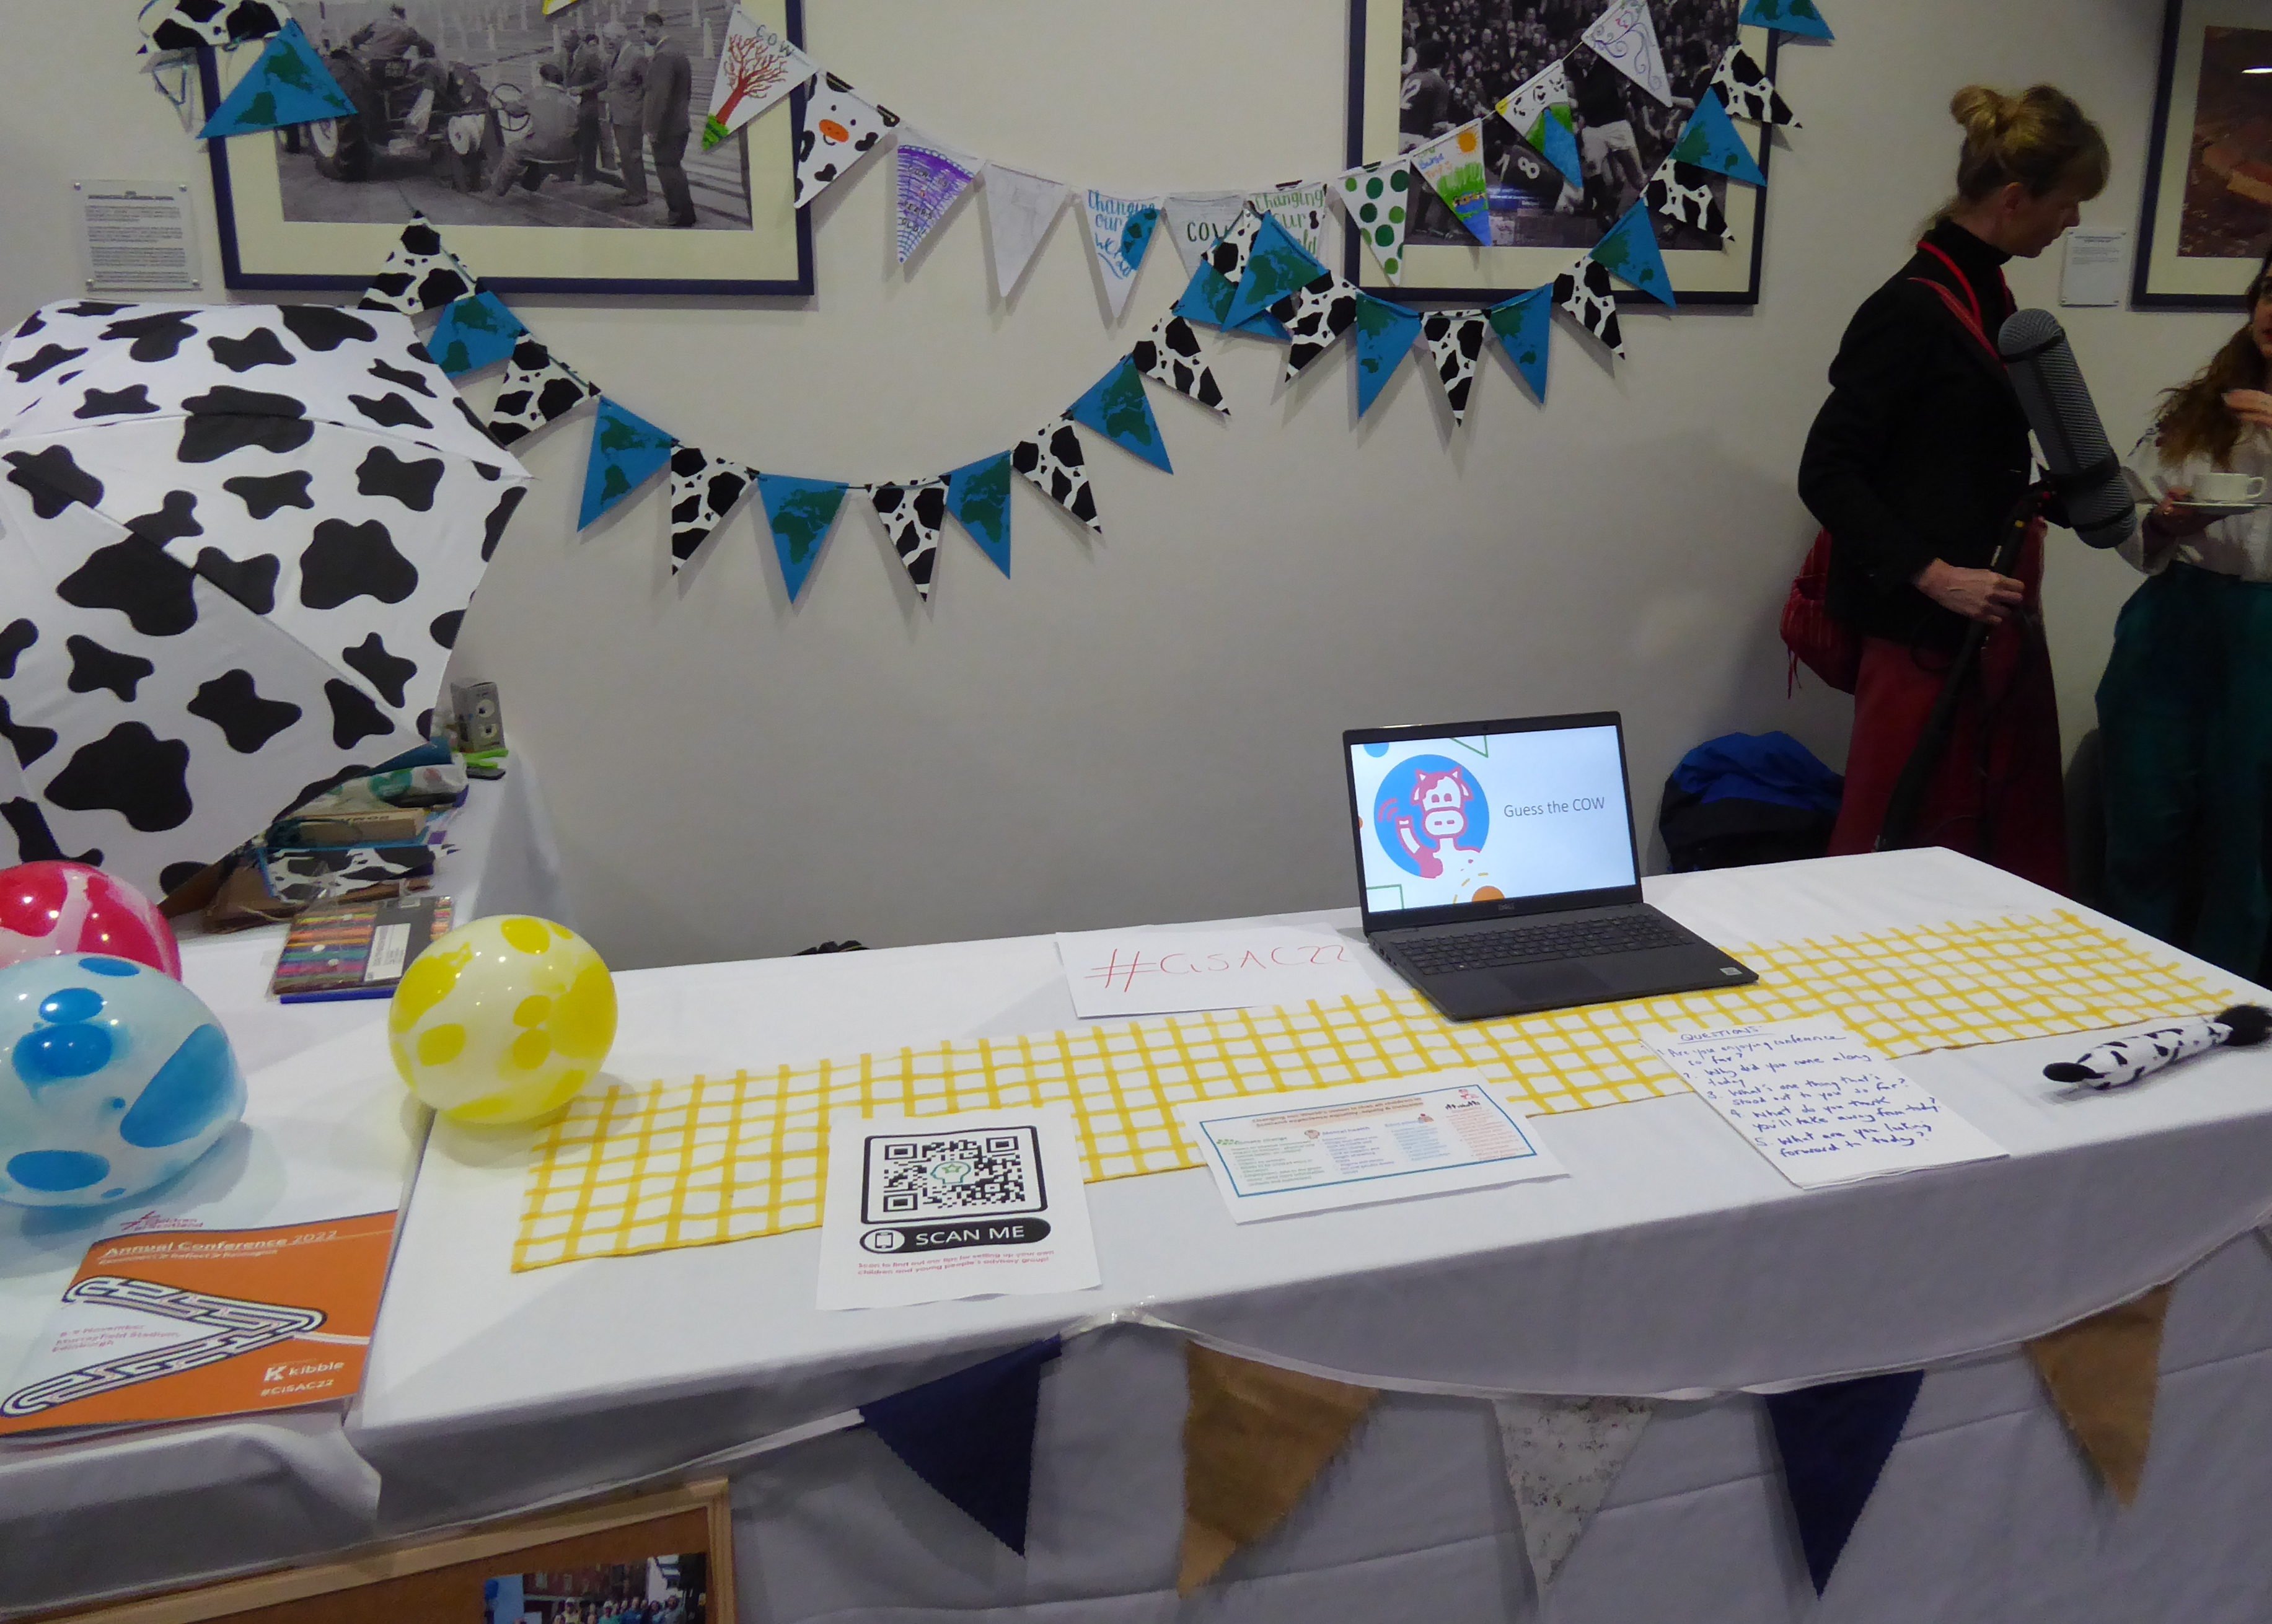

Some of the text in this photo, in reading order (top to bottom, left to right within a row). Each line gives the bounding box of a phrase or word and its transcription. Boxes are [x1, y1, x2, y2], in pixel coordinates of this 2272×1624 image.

[756, 24, 795, 57] COW
[1095, 214, 1123, 232] our
[1504, 797, 1605, 818] Guess the COW
[1703, 1067, 1738, 1078] Why
[1765, 1063, 1787, 1073] you
[1801, 1104, 1816, 1113] do
[102, 1230, 338, 1258] Annual Conference 2022
[915, 1225, 1025, 1246] SCAN ME
[288, 1361, 345, 1376] kibble
